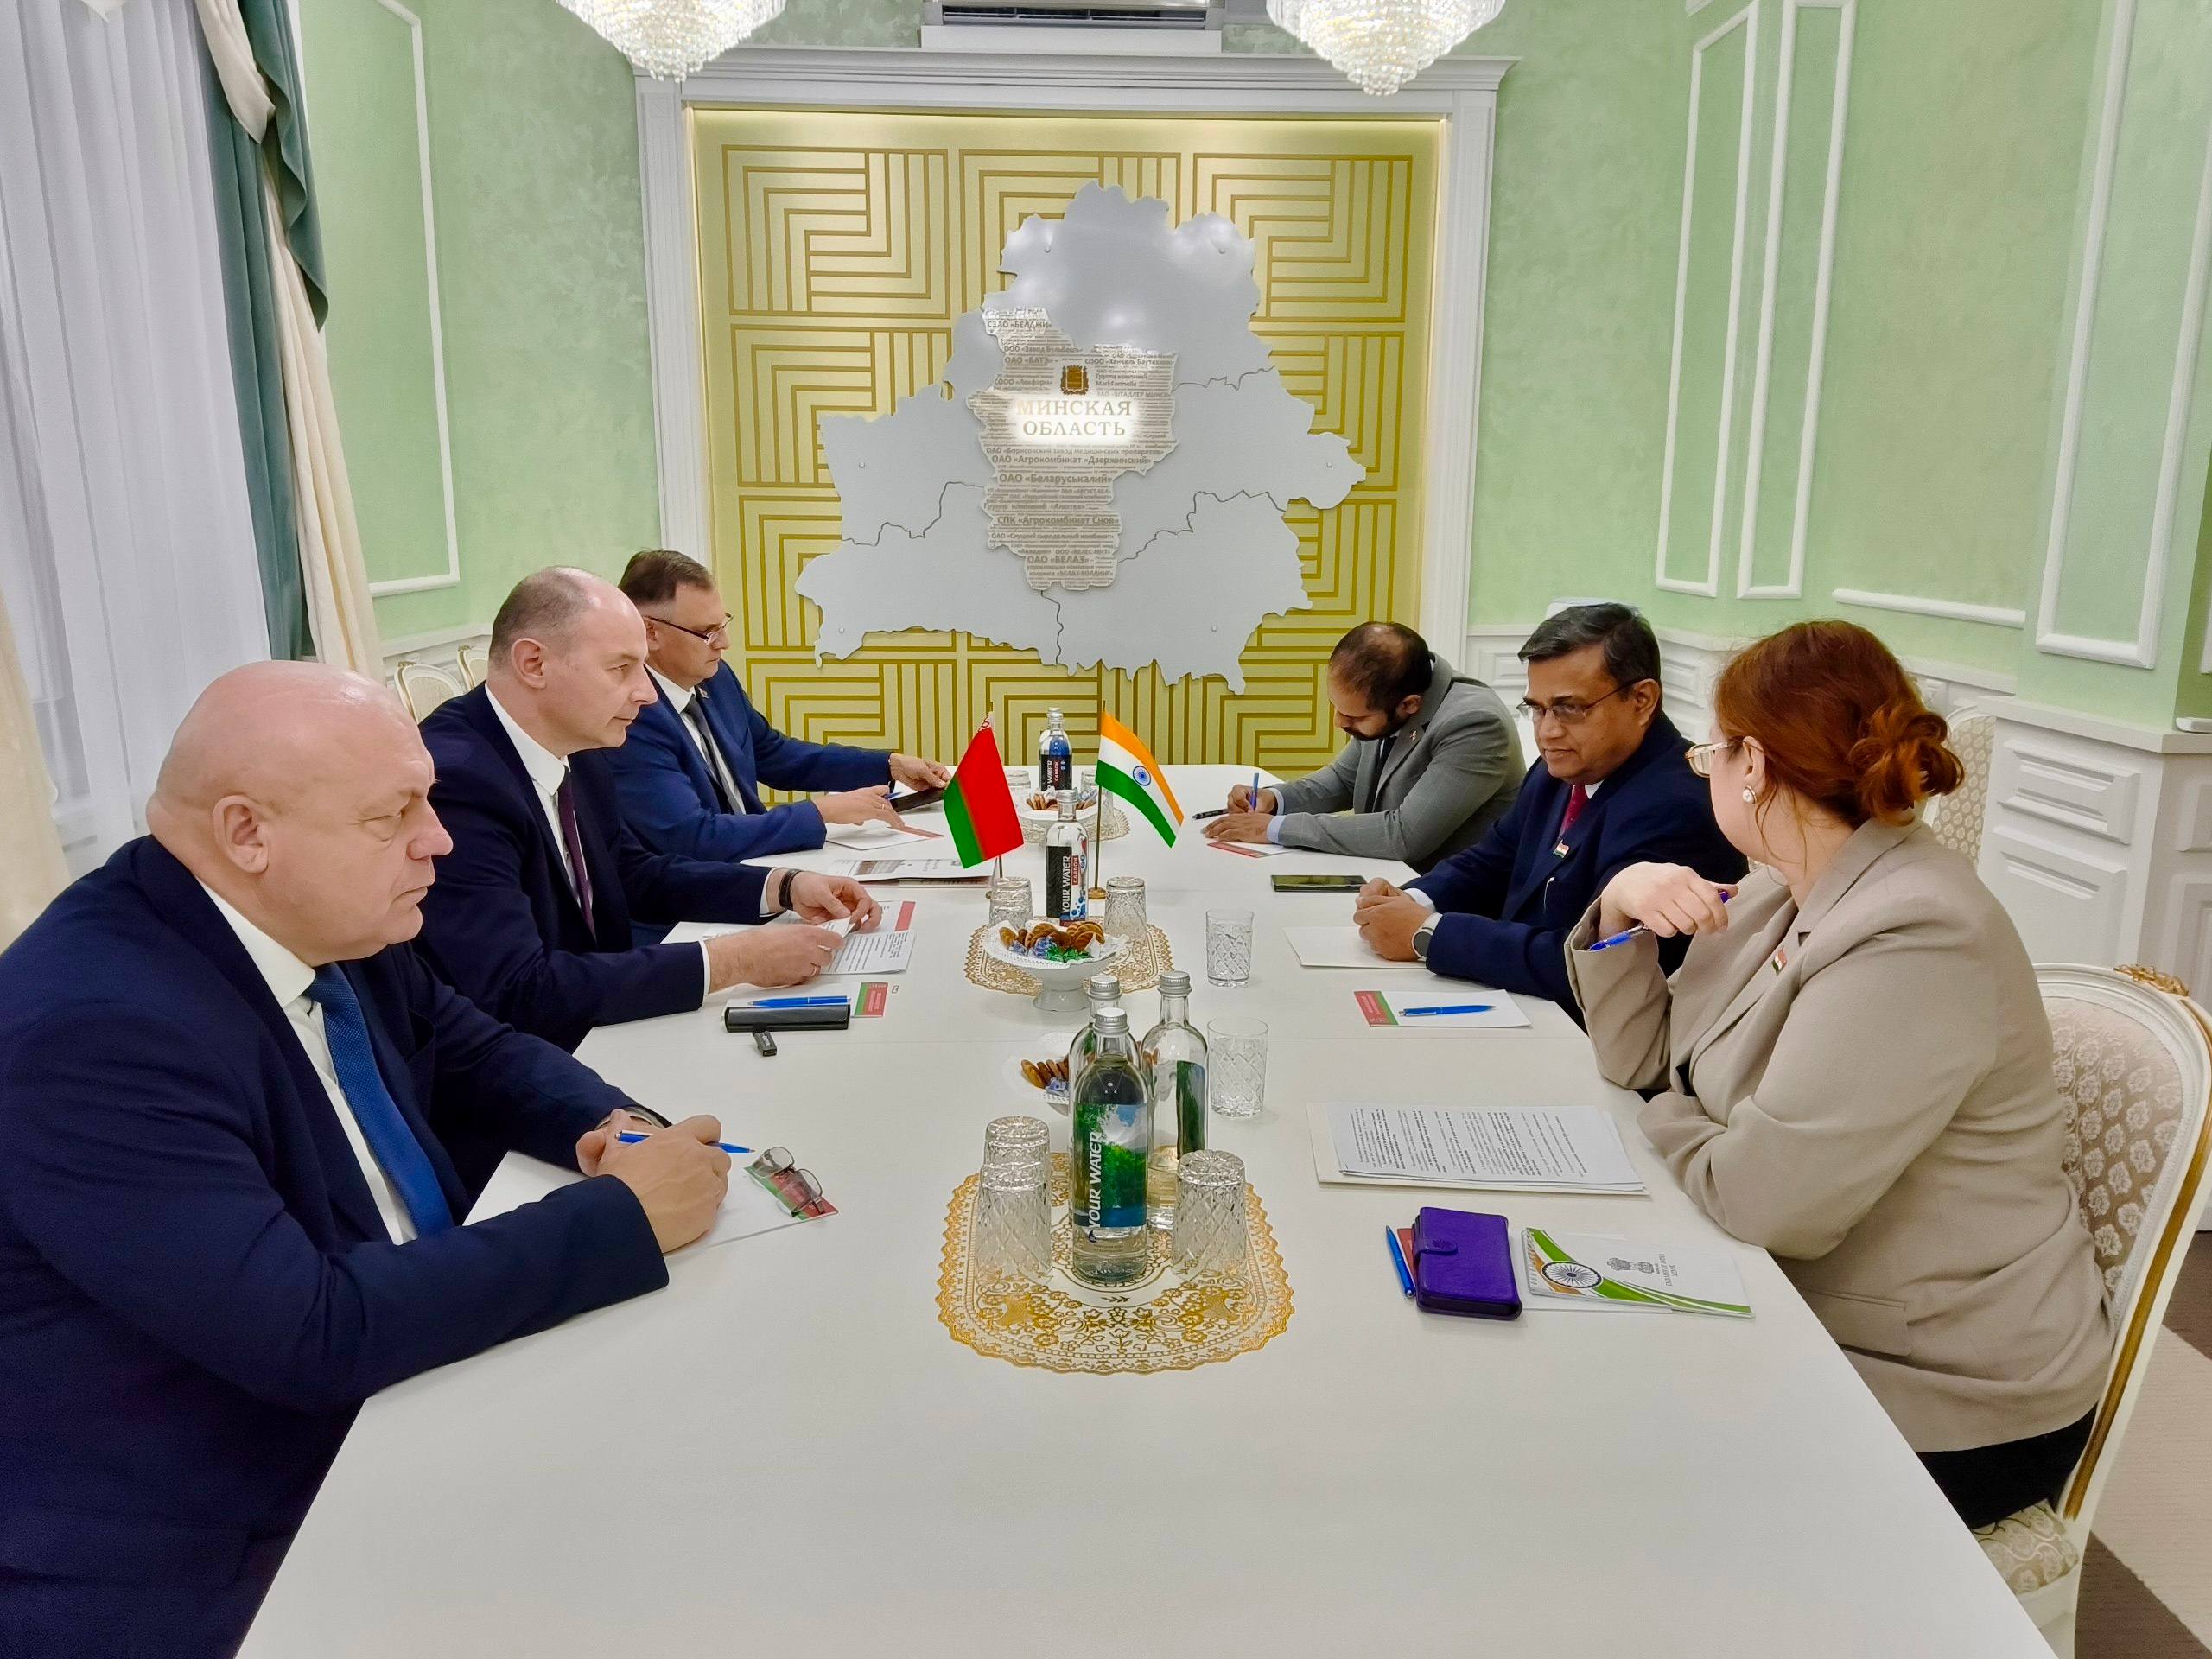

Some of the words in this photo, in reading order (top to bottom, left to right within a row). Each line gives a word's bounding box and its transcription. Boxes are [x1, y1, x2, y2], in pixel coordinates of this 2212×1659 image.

[1017, 400, 1132, 416] МИНСКАЯ
[1023, 421, 1126, 436] ОБЛАСТЬ
[1014, 455, 1082, 465] «Агрокомбинат
[999, 474, 1023, 482] ОАО
[1025, 474, 1113, 485] «Беларуськалий»
[1018, 517, 1090, 526] «Агрокомбинат
[1050, 556, 1090, 564] «БЕЛАЗ»
[1062, 855, 1071, 887] WATER
[1062, 888, 1071, 914] YOUR
[1089, 1132, 1102, 1184] WATER
[1089, 1189, 1101, 1229] YOUR
